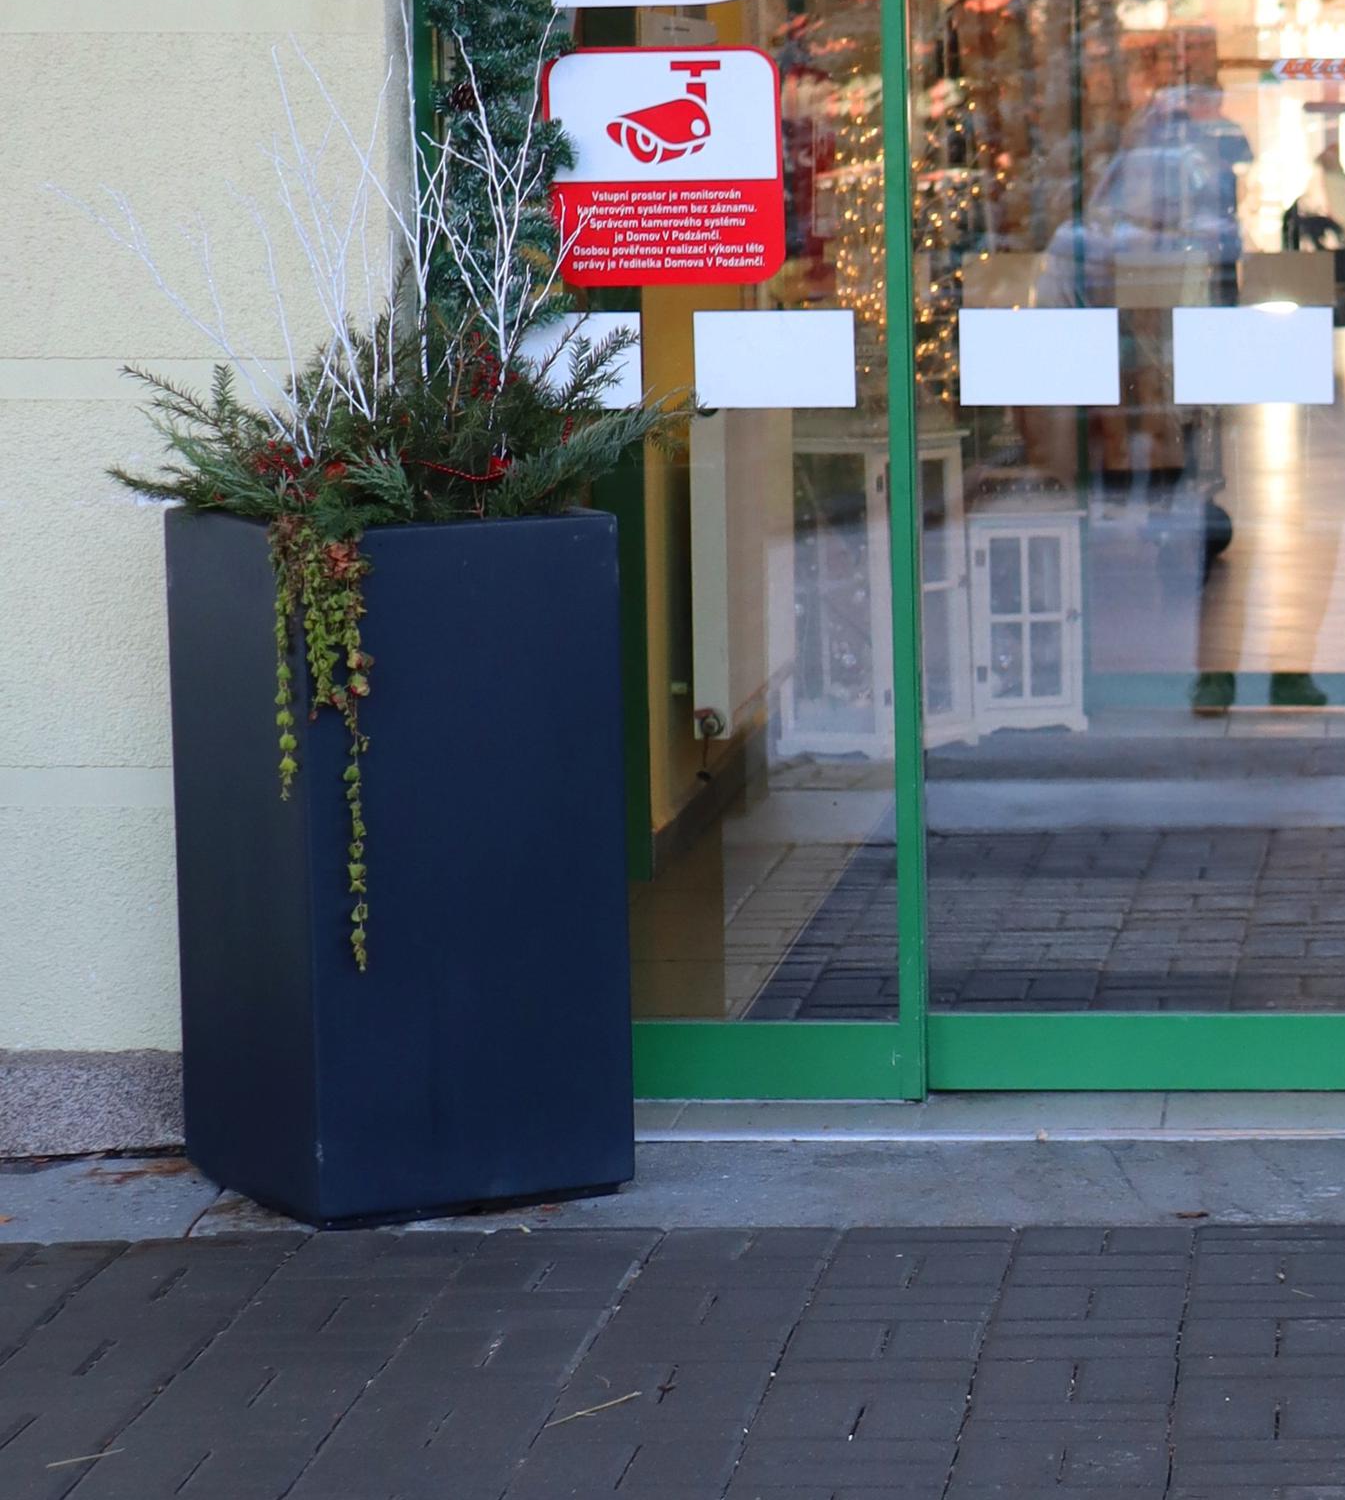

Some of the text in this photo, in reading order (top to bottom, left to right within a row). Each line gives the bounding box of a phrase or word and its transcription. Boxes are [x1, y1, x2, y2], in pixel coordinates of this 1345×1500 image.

[592, 188, 741, 203] Vstupní prostor je monitorován
[637, 203, 688, 216] systémem
[690, 203, 708, 213] bez
[710, 203, 757, 213] záznamu.
[590, 216, 746, 230] Správcem kamerového systému
[615, 231, 624, 244] je
[626, 231, 661, 241] Domov
[662, 231, 669, 240] V
[573, 243, 764, 257] Osobou pověřenou realizací výkonu této
[572, 259, 605, 271] správy
[607, 259, 616, 271] je
[619, 258, 661, 269] ředitelka
[664, 257, 704, 268] Domova
[706, 257, 713, 267] V
